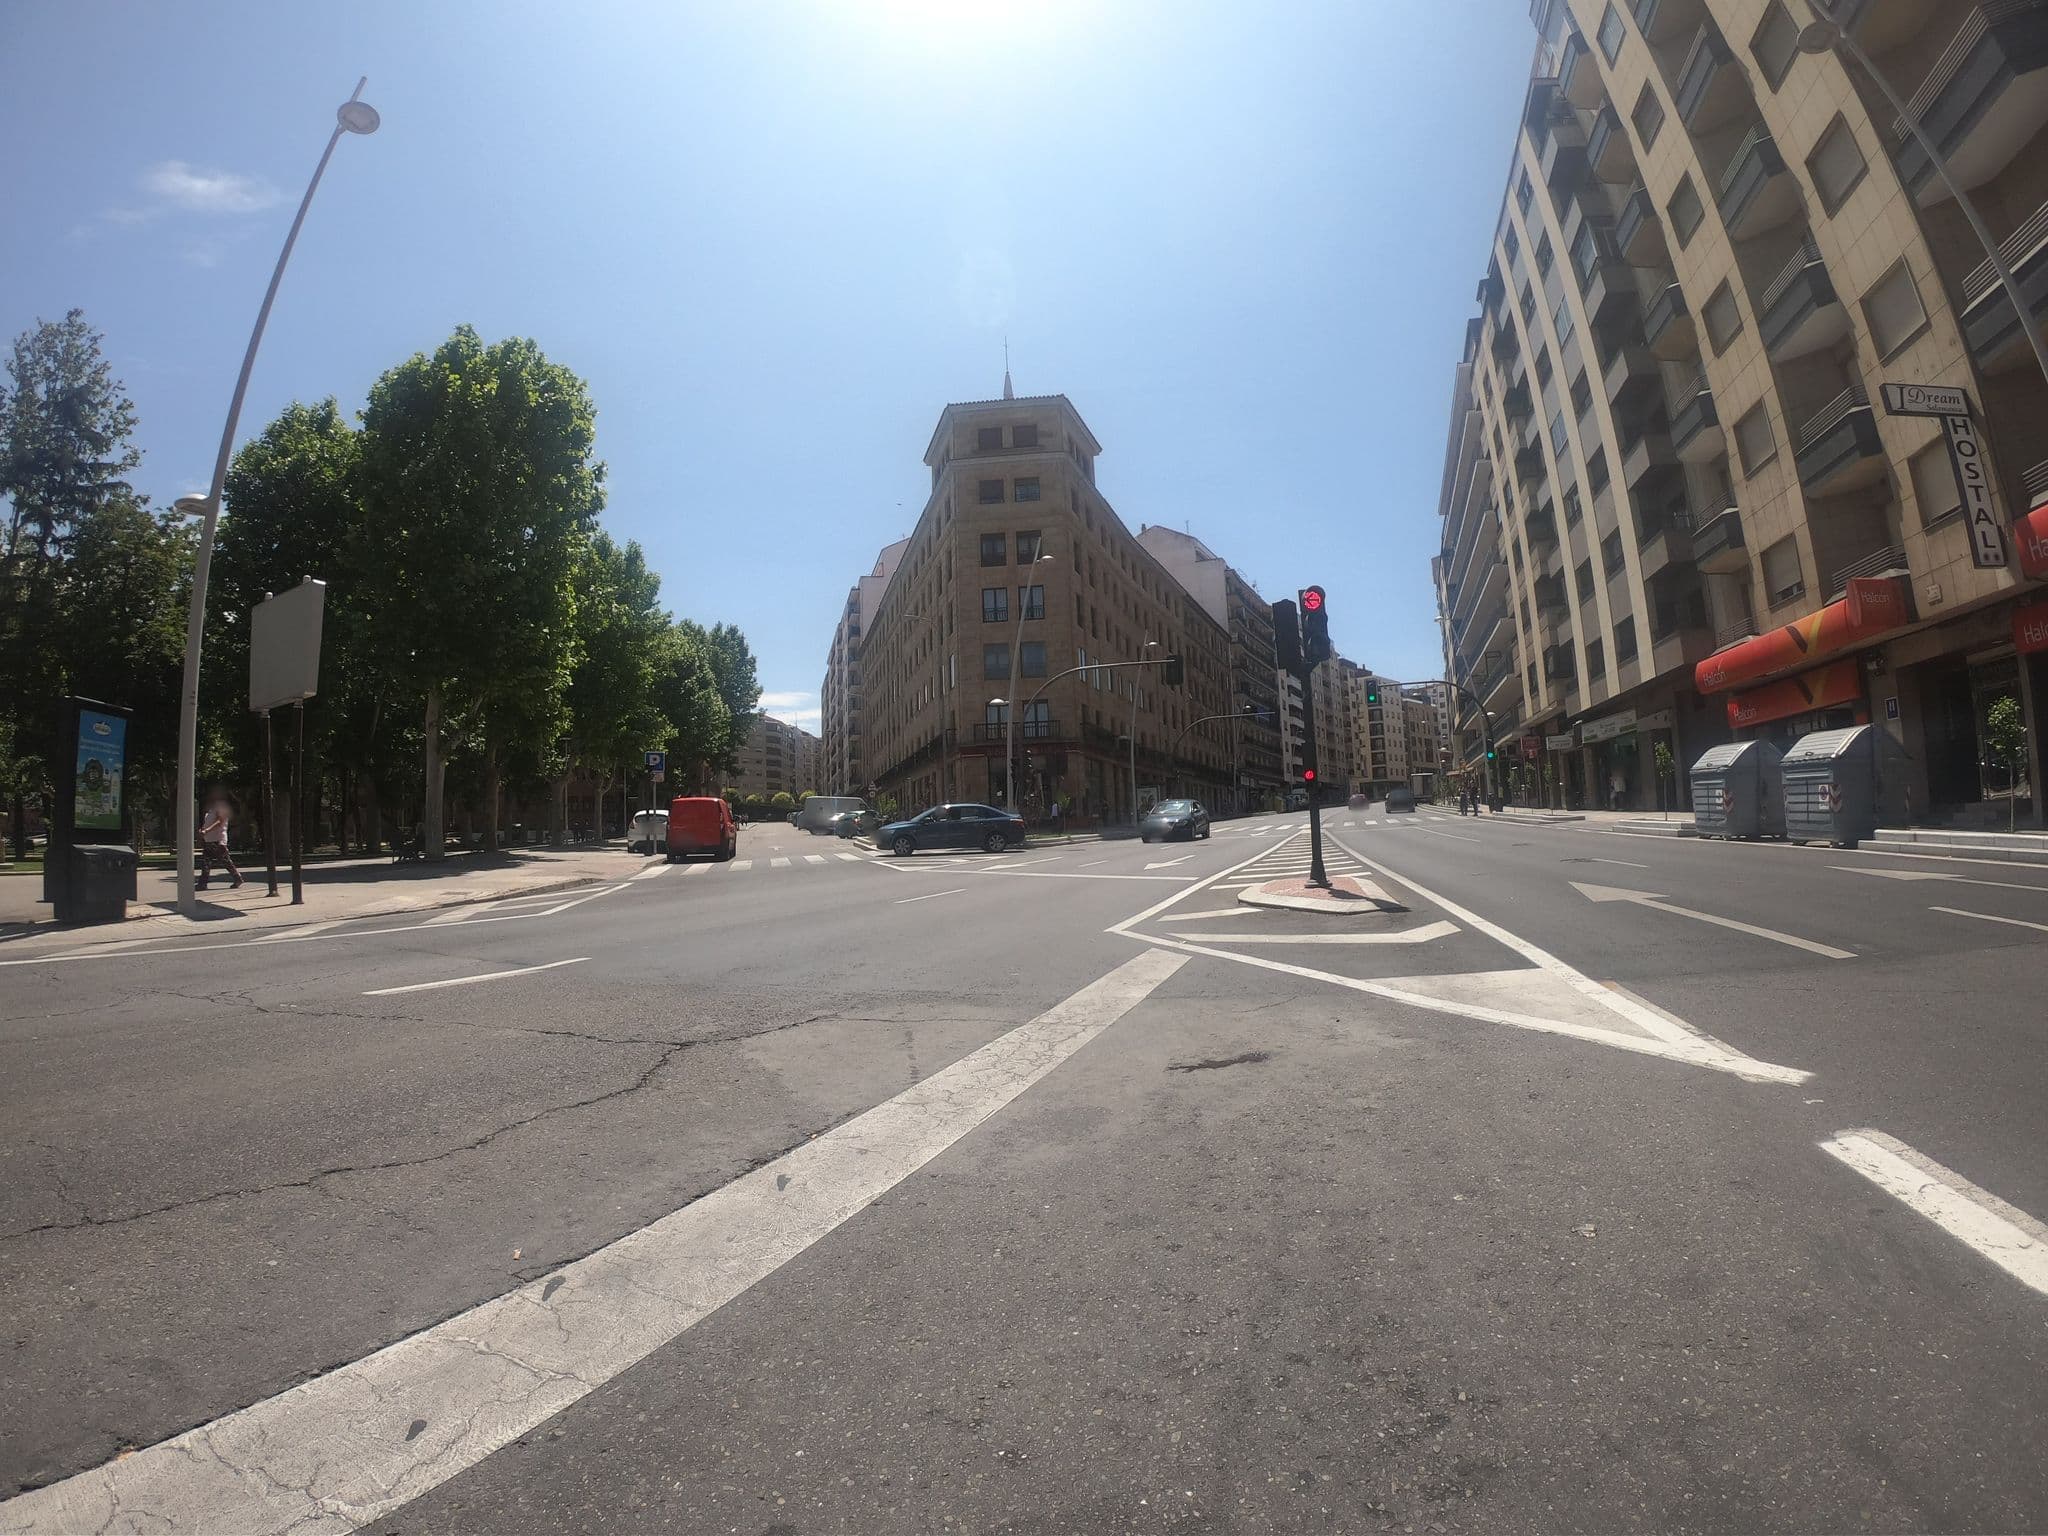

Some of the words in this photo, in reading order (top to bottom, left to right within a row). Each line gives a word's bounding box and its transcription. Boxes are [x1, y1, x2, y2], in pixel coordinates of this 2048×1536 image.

[1896, 386, 1906, 410] I
[1908, 387, 1960, 405] Dream
[1951, 418, 1997, 549] HOSTAL
